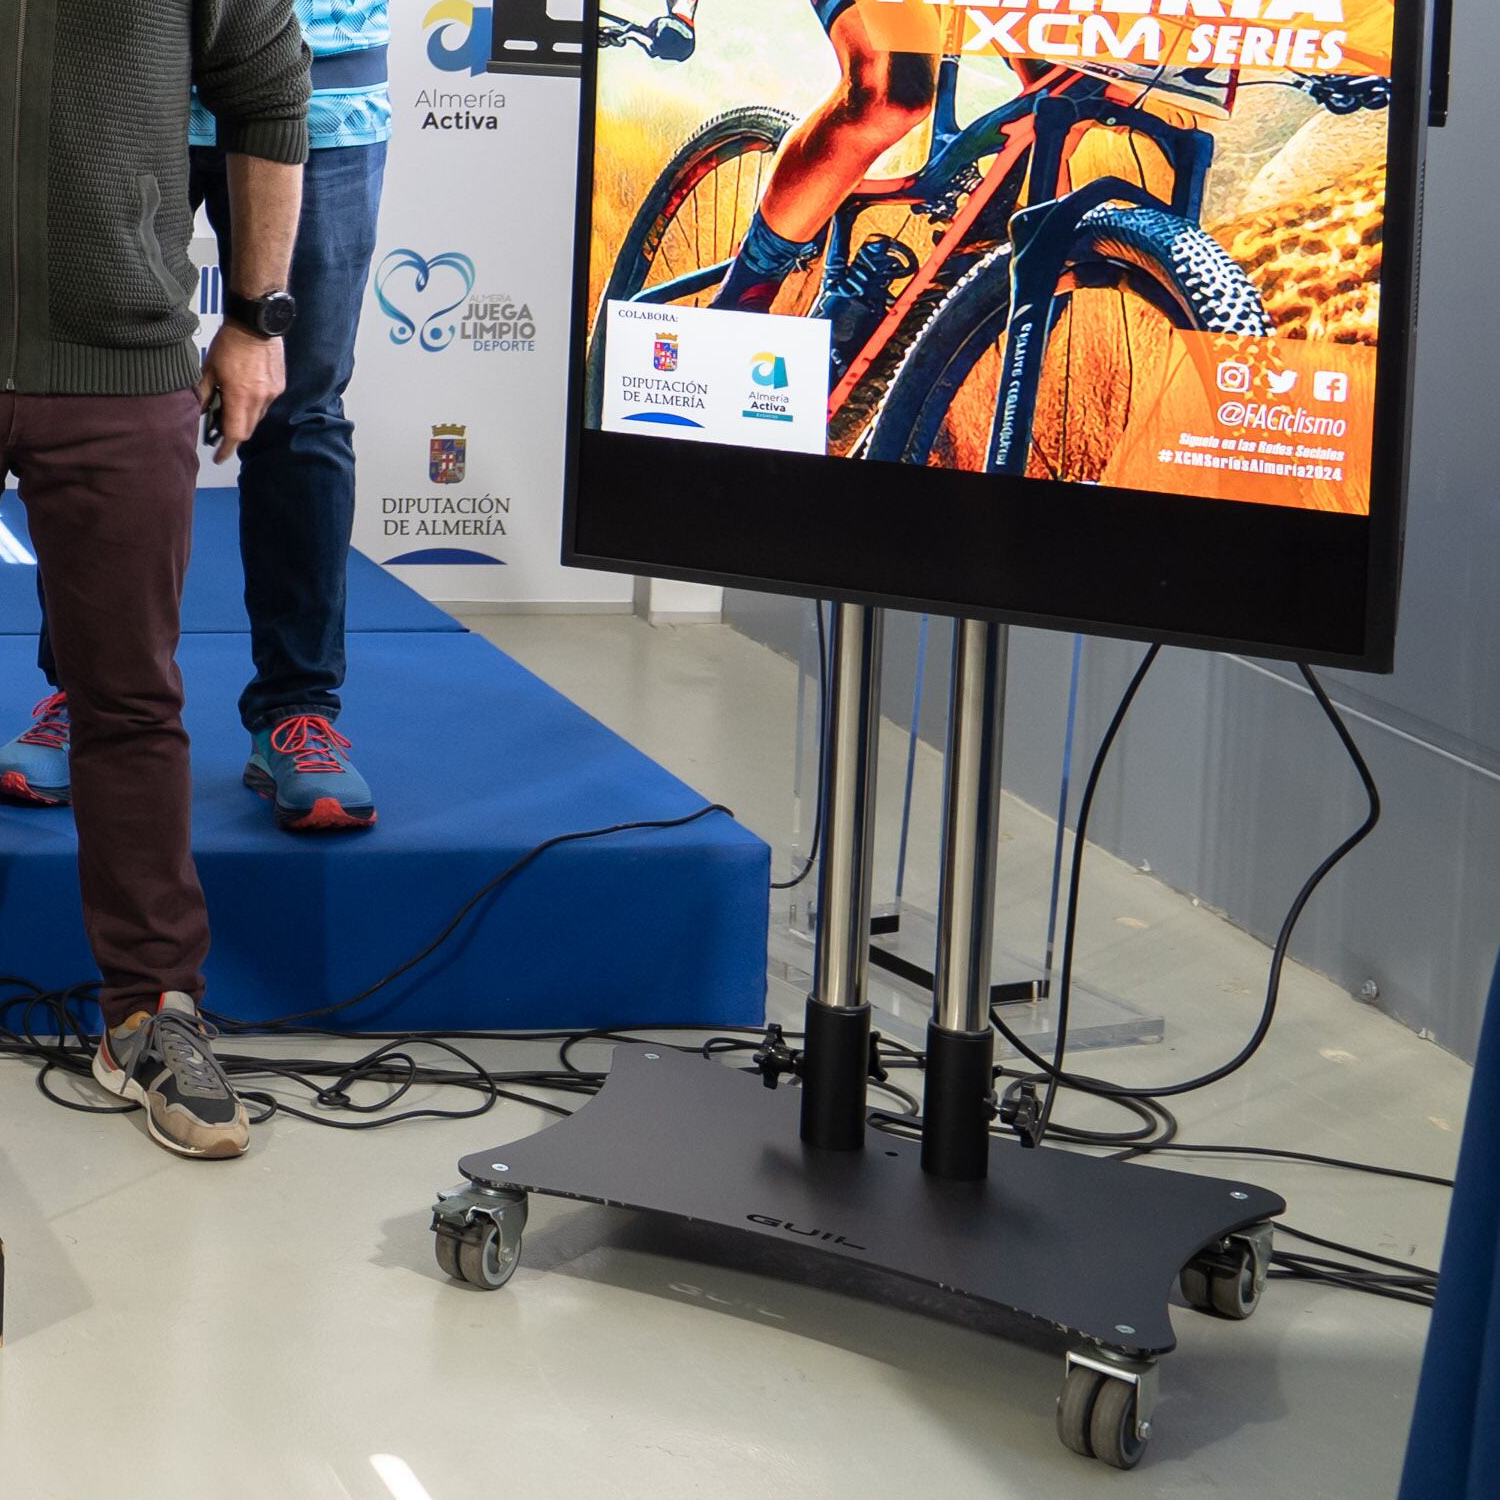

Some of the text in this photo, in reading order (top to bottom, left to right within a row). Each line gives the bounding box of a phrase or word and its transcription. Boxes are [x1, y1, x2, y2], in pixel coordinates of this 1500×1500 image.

[961, 9, 1347, 70] XCM SERIES
[415, 89, 505, 112] Almería
[422, 111, 497, 130] Activa
[459, 301, 533, 321] JUEGA
[618, 309, 679, 323] COLABORA:
[461, 320, 536, 339] LIMPIO
[468, 338, 535, 351] DEPORTE
[622, 376, 708, 395] DIPUTACIÓN
[623, 391, 705, 409] DE ALMERÍA
[751, 401, 786, 412] Activa
[1217, 401, 1346, 437] @FACiclismo
[1238, 438, 1256, 452] las
[1295, 443, 1345, 462] Sociales
[382, 494, 510, 518] DIPUTACIÓN
[384, 515, 506, 535] DE ALMERÍA
[746, 1214, 867, 1251] GUIL
